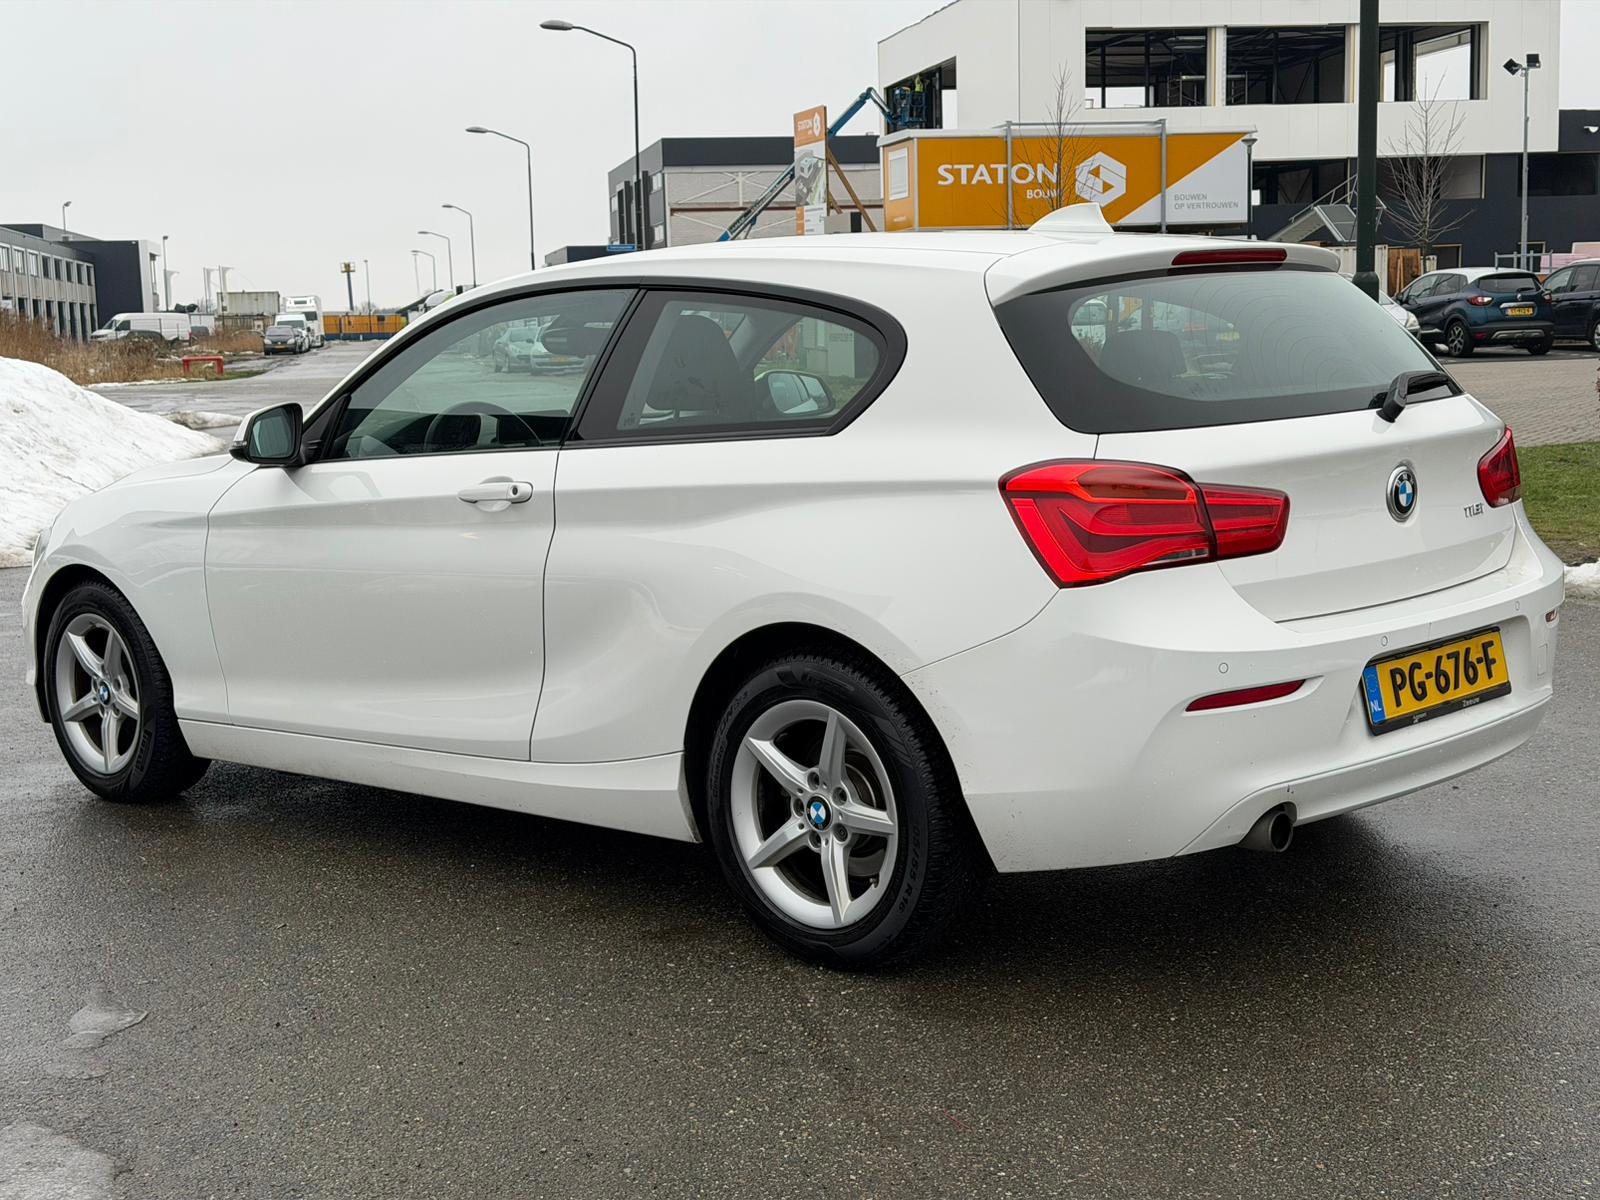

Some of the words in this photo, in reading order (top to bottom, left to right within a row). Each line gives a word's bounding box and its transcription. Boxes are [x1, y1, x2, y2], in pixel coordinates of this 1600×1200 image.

[937, 163, 1059, 186] STATON
[1174, 193, 1208, 201] BOUWEN
[1174, 202, 1185, 210] OP
[1186, 201, 1239, 209] VERTROUWEN
[1389, 640, 1497, 708] PG-676-F
[1370, 699, 1383, 713] NL
